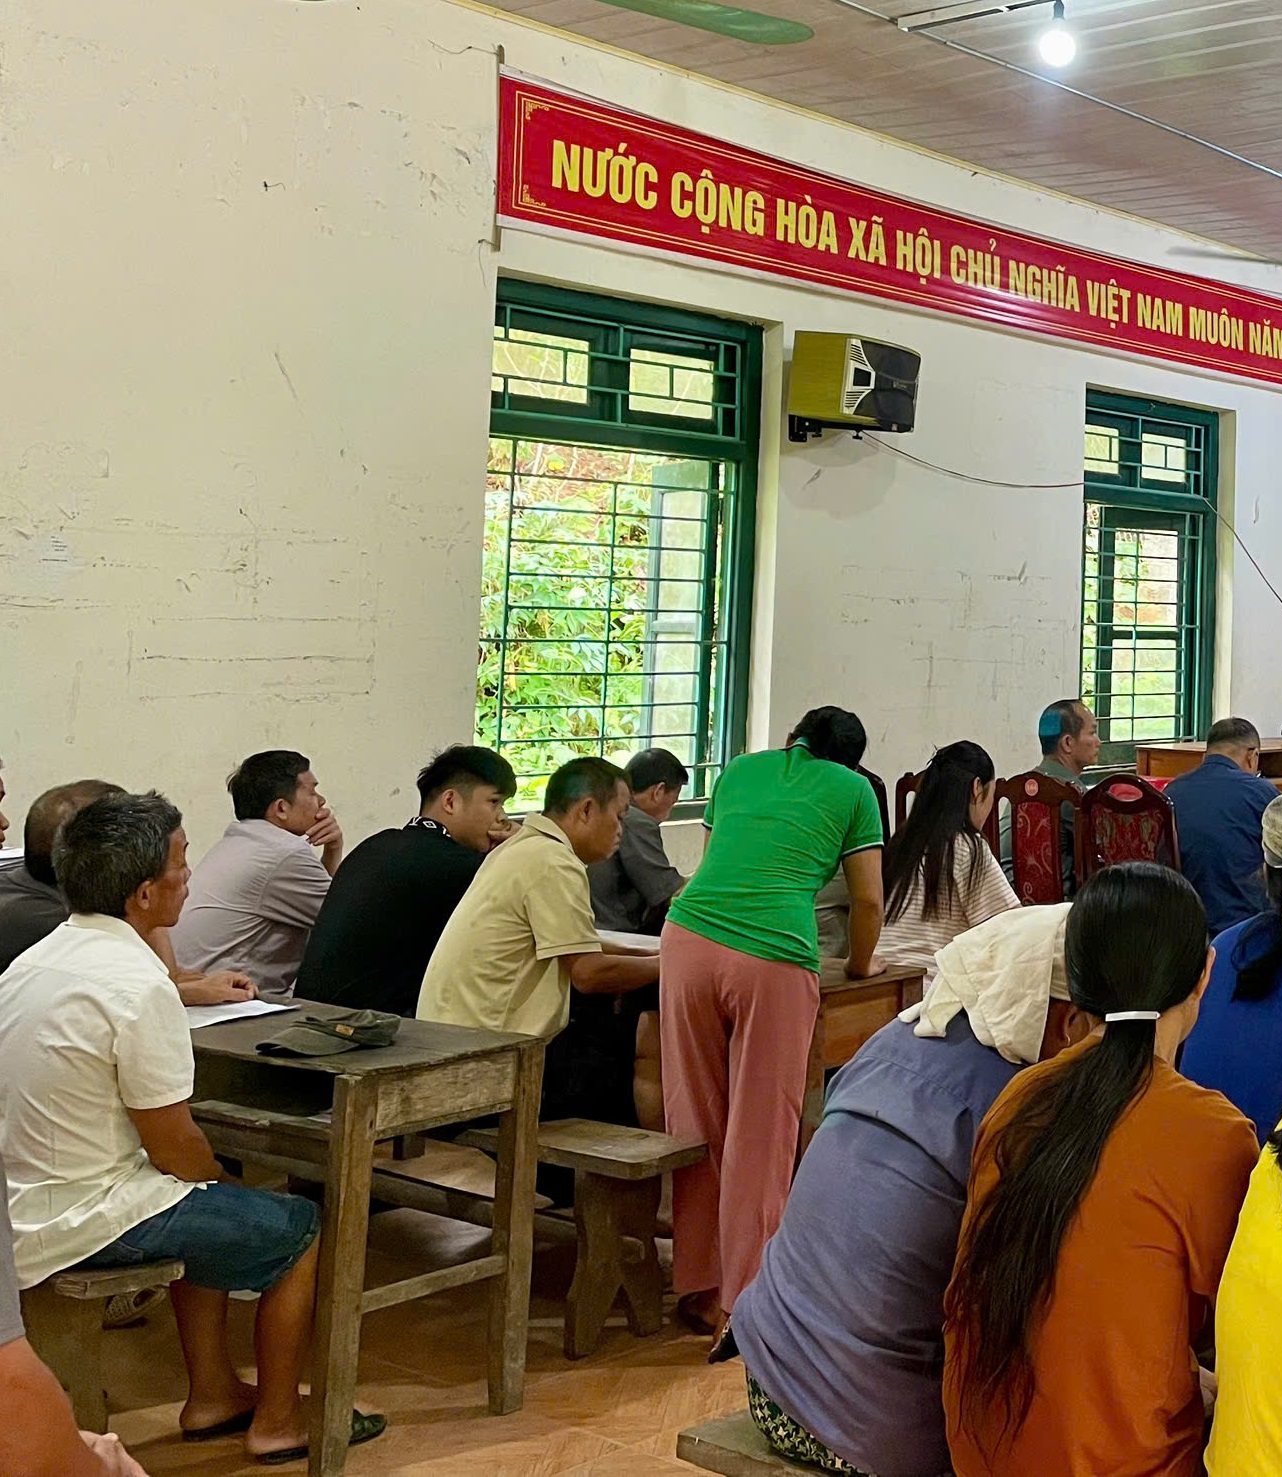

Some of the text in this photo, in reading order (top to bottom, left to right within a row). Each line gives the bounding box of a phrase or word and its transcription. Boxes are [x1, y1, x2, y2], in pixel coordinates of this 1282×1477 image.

[552, 140, 658, 210] NƯỚC
[671, 169, 765, 235] CỘNG
[776, 195, 838, 254] HÒA
[847, 215, 887, 266] XÃ
[896, 227, 941, 285] HỘI
[950, 239, 1000, 290] CHỦ
[1009, 265, 1080, 312] NGHĨA
[1087, 278, 1130, 329] VIỆT
[1137, 294, 1183, 337] NAM
[1189, 308, 1244, 351] MUÔN
